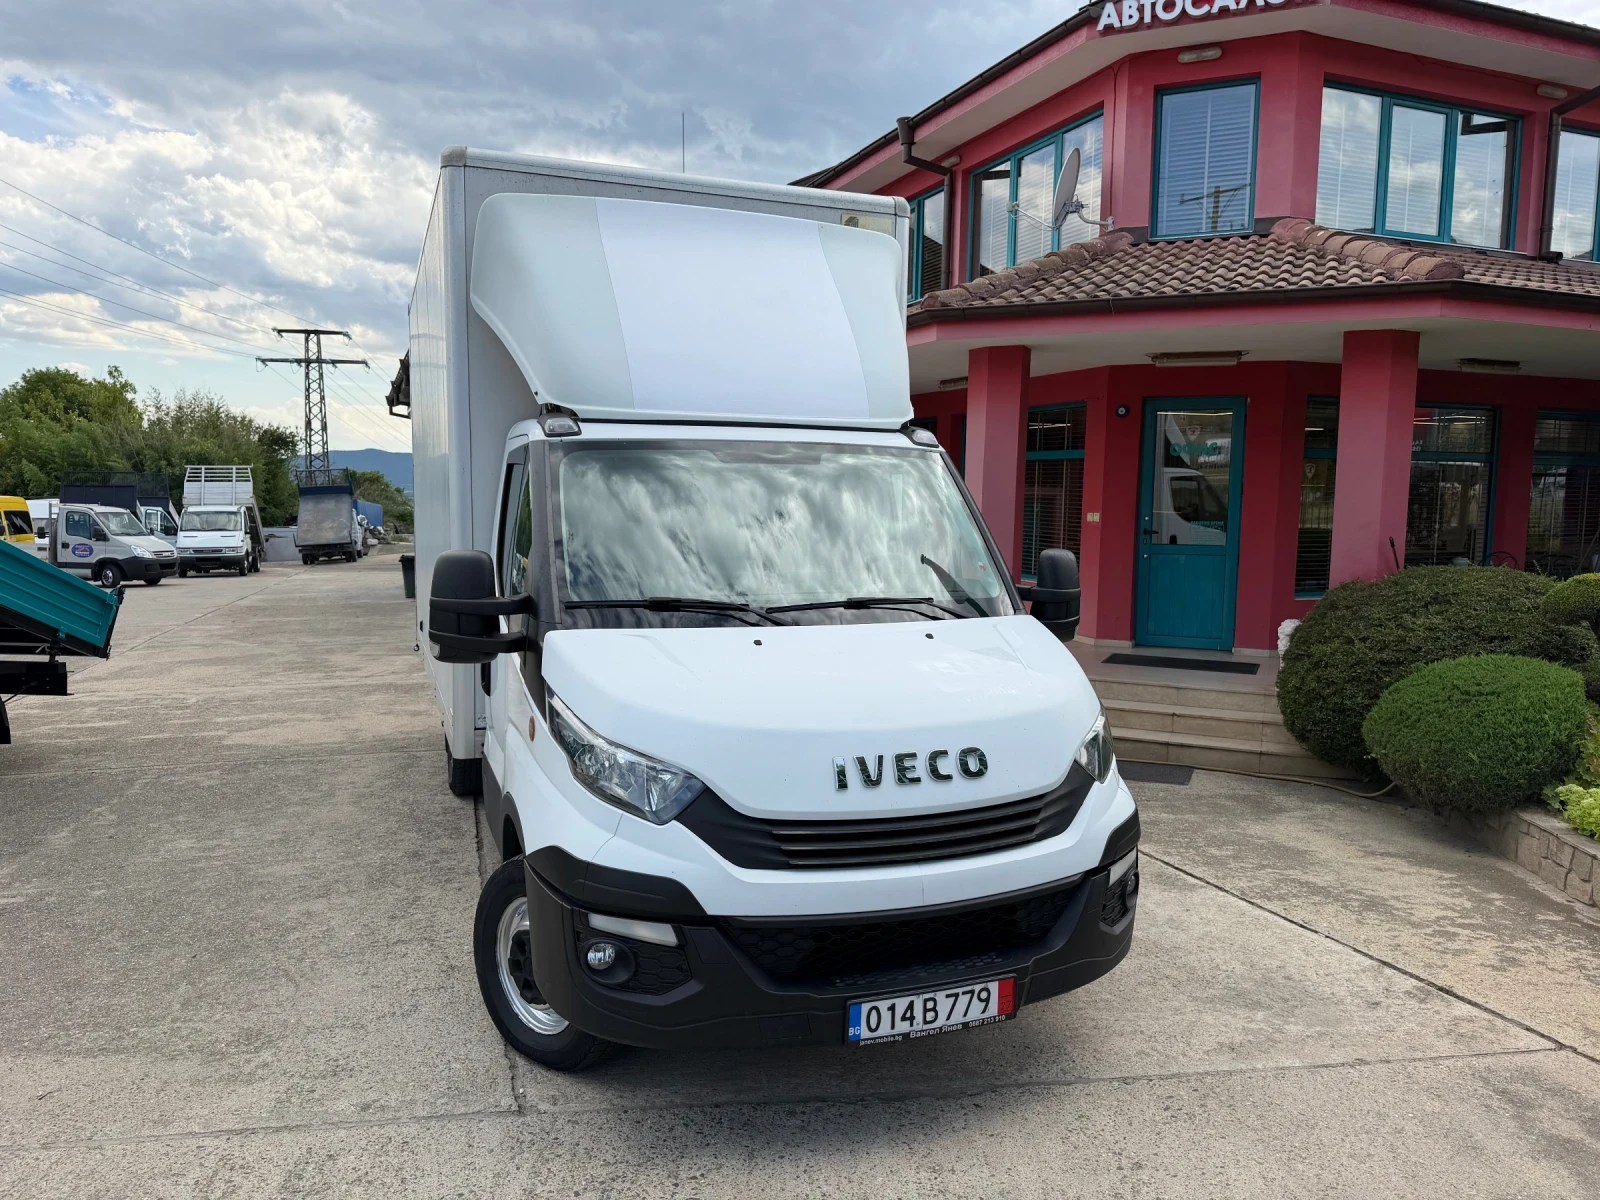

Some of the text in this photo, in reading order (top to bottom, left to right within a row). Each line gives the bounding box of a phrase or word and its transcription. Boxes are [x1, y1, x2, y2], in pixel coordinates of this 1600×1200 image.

[1169, 441, 1218, 457] ОФИС
[832, 746, 988, 791] IVECO
[848, 1026, 861, 1036] BG
[909, 1023, 963, 1039] Вангел Янев
[859, 1034, 903, 1047] janev.mobile.bg
